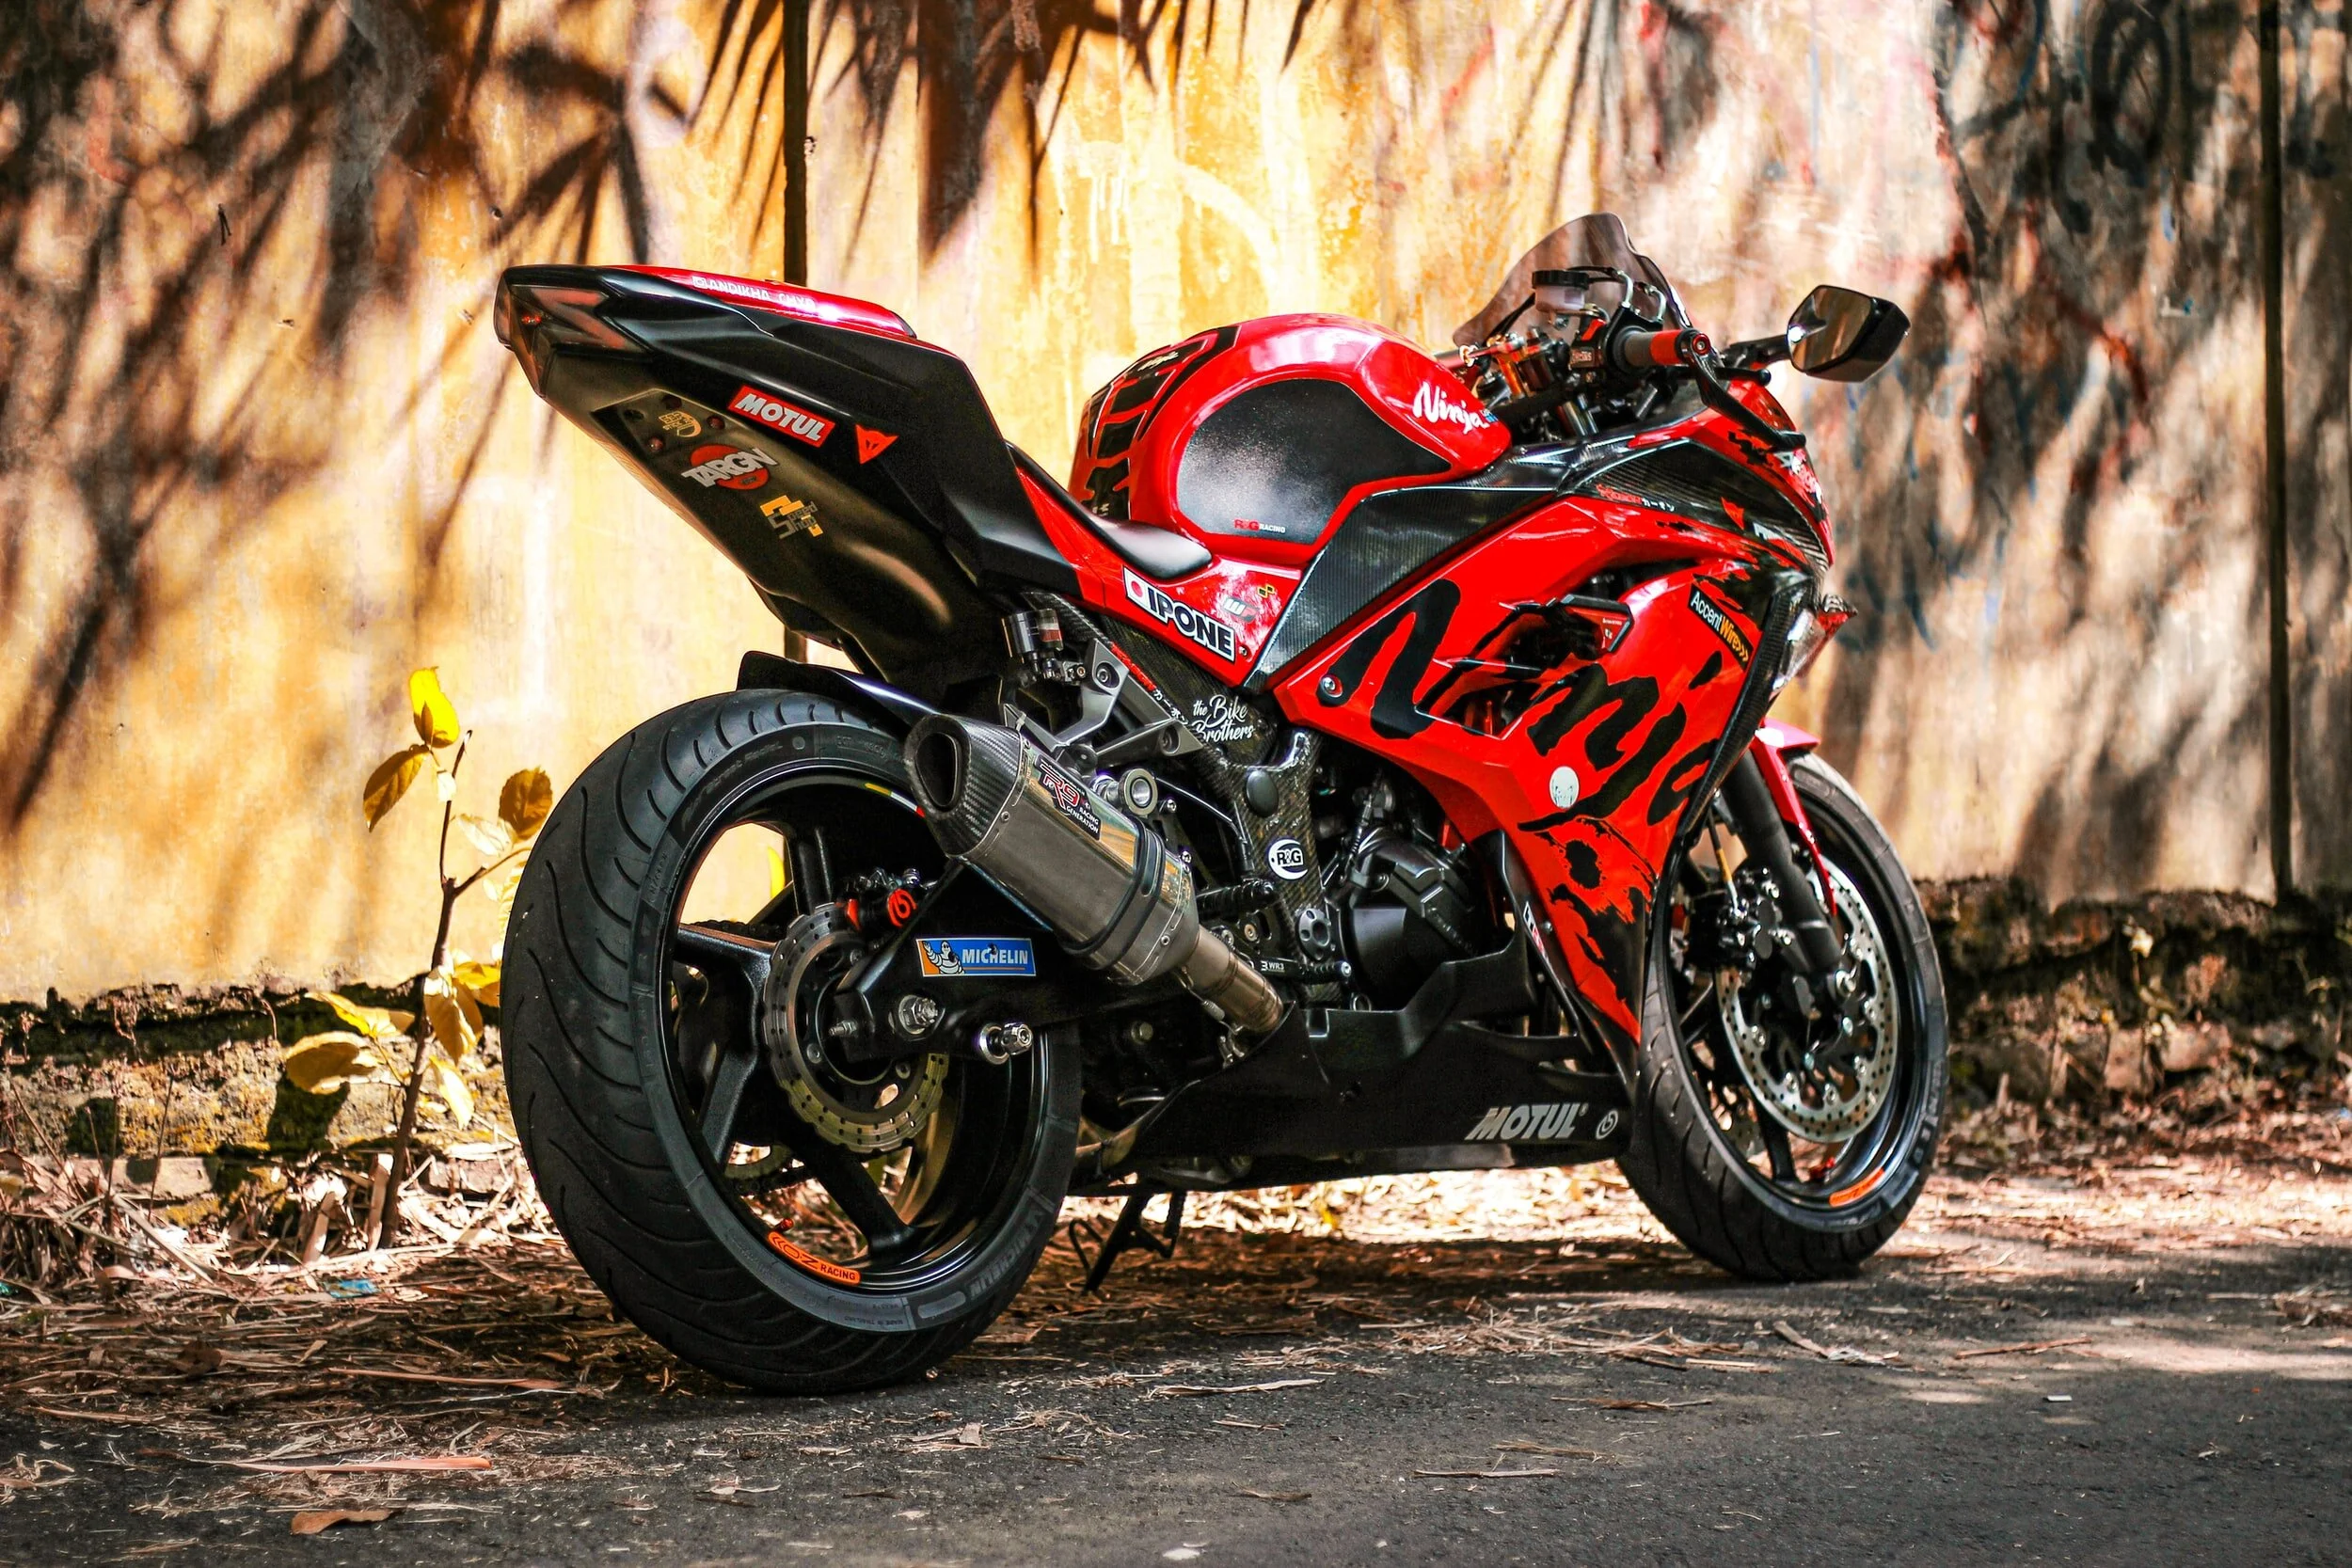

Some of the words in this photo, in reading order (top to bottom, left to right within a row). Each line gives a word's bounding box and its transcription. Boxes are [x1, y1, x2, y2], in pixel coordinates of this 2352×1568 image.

[735, 393, 825, 441] MOTUL
[1412, 381, 1490, 435] Ninja
[1147, 586, 1232, 657] IPONE
[1192, 700, 1208, 717] the
[1205, 694, 1248, 728] Bike
[1191, 720, 1256, 743] Brothers
[1066, 805, 1099, 833] GENERATION
[1079, 807, 1099, 826] RACING
[1277, 849, 1302, 865] R&G
[961, 949, 1028, 964] MICHELIN
[820, 1264, 856, 1280] RACING
